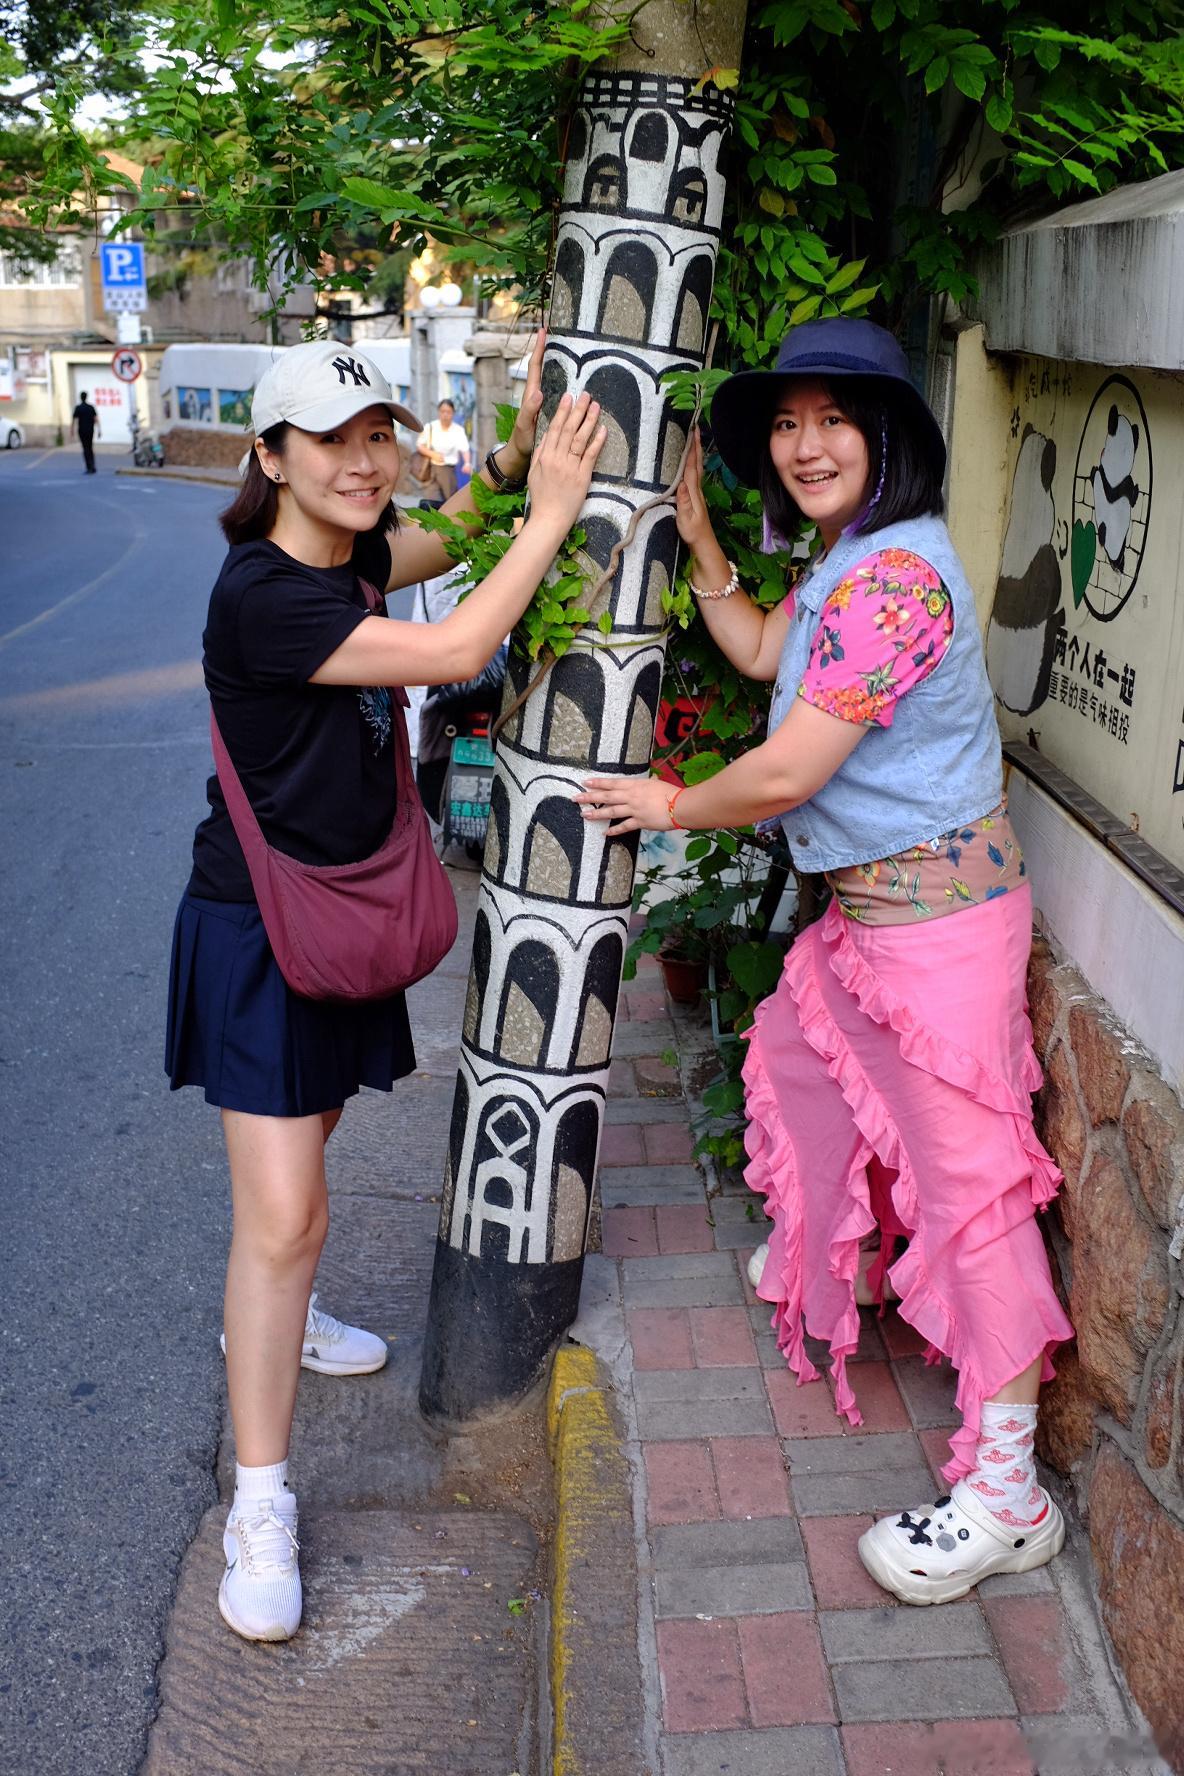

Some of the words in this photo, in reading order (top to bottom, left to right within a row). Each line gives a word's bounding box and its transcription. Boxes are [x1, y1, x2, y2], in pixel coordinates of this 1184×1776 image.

[105, 248, 133, 281] P
[332, 356, 370, 387] NY
[1054, 627, 1136, 707] 两个人在一起
[1049, 671, 1130, 745] 重要的是气味相投
